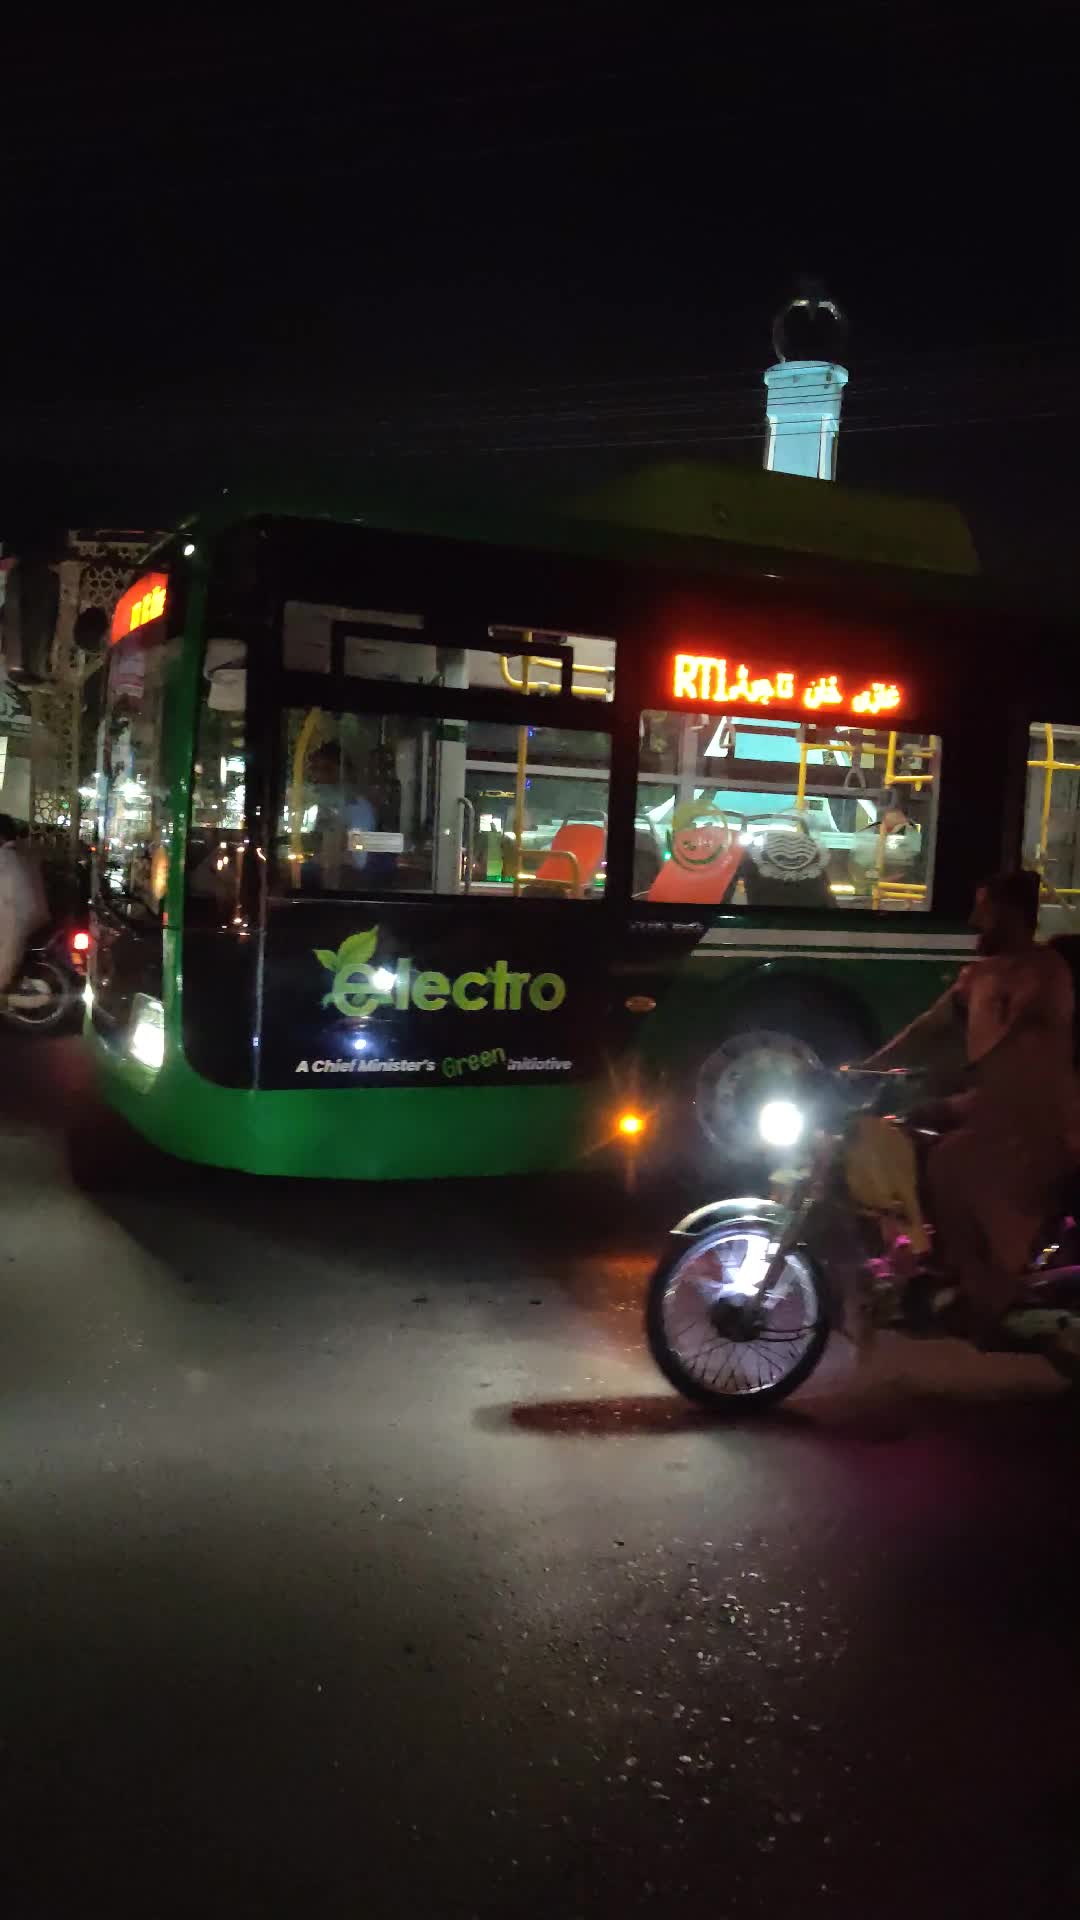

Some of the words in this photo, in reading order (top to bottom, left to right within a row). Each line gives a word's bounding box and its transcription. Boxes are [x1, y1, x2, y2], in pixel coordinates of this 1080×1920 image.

[330, 957, 566, 1017] electro
[296, 1060, 309, 1073] A
[312, 1059, 356, 1073] Chief
[359, 1058, 436, 1072] Minister's
[441, 1047, 506, 1078] Green
